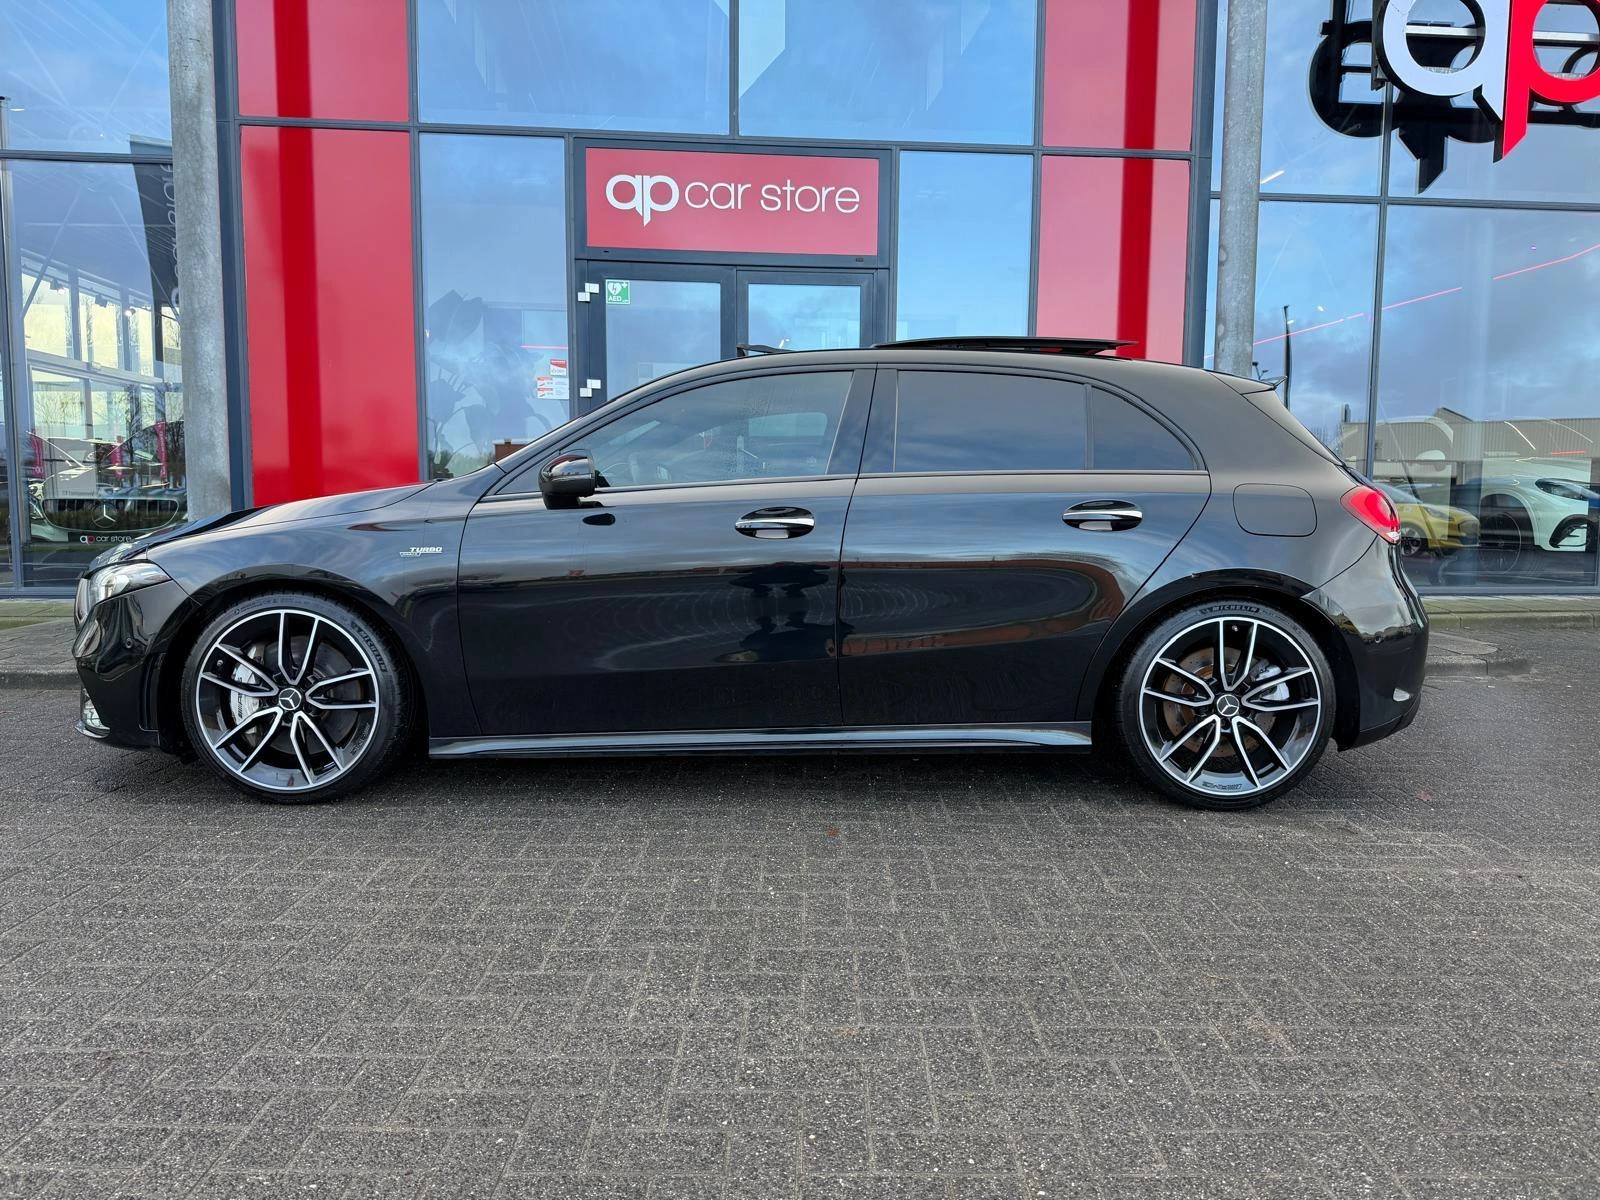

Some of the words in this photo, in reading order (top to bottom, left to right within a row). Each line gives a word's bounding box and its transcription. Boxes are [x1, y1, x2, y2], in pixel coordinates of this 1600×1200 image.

[605, 174, 680, 227] ap
[685, 182, 751, 210] car
[760, 179, 860, 214] store
[110, 534, 132, 543] store
[1212, 604, 1259, 613] MICHELIN
[359, 630, 387, 671] MICHELIN
